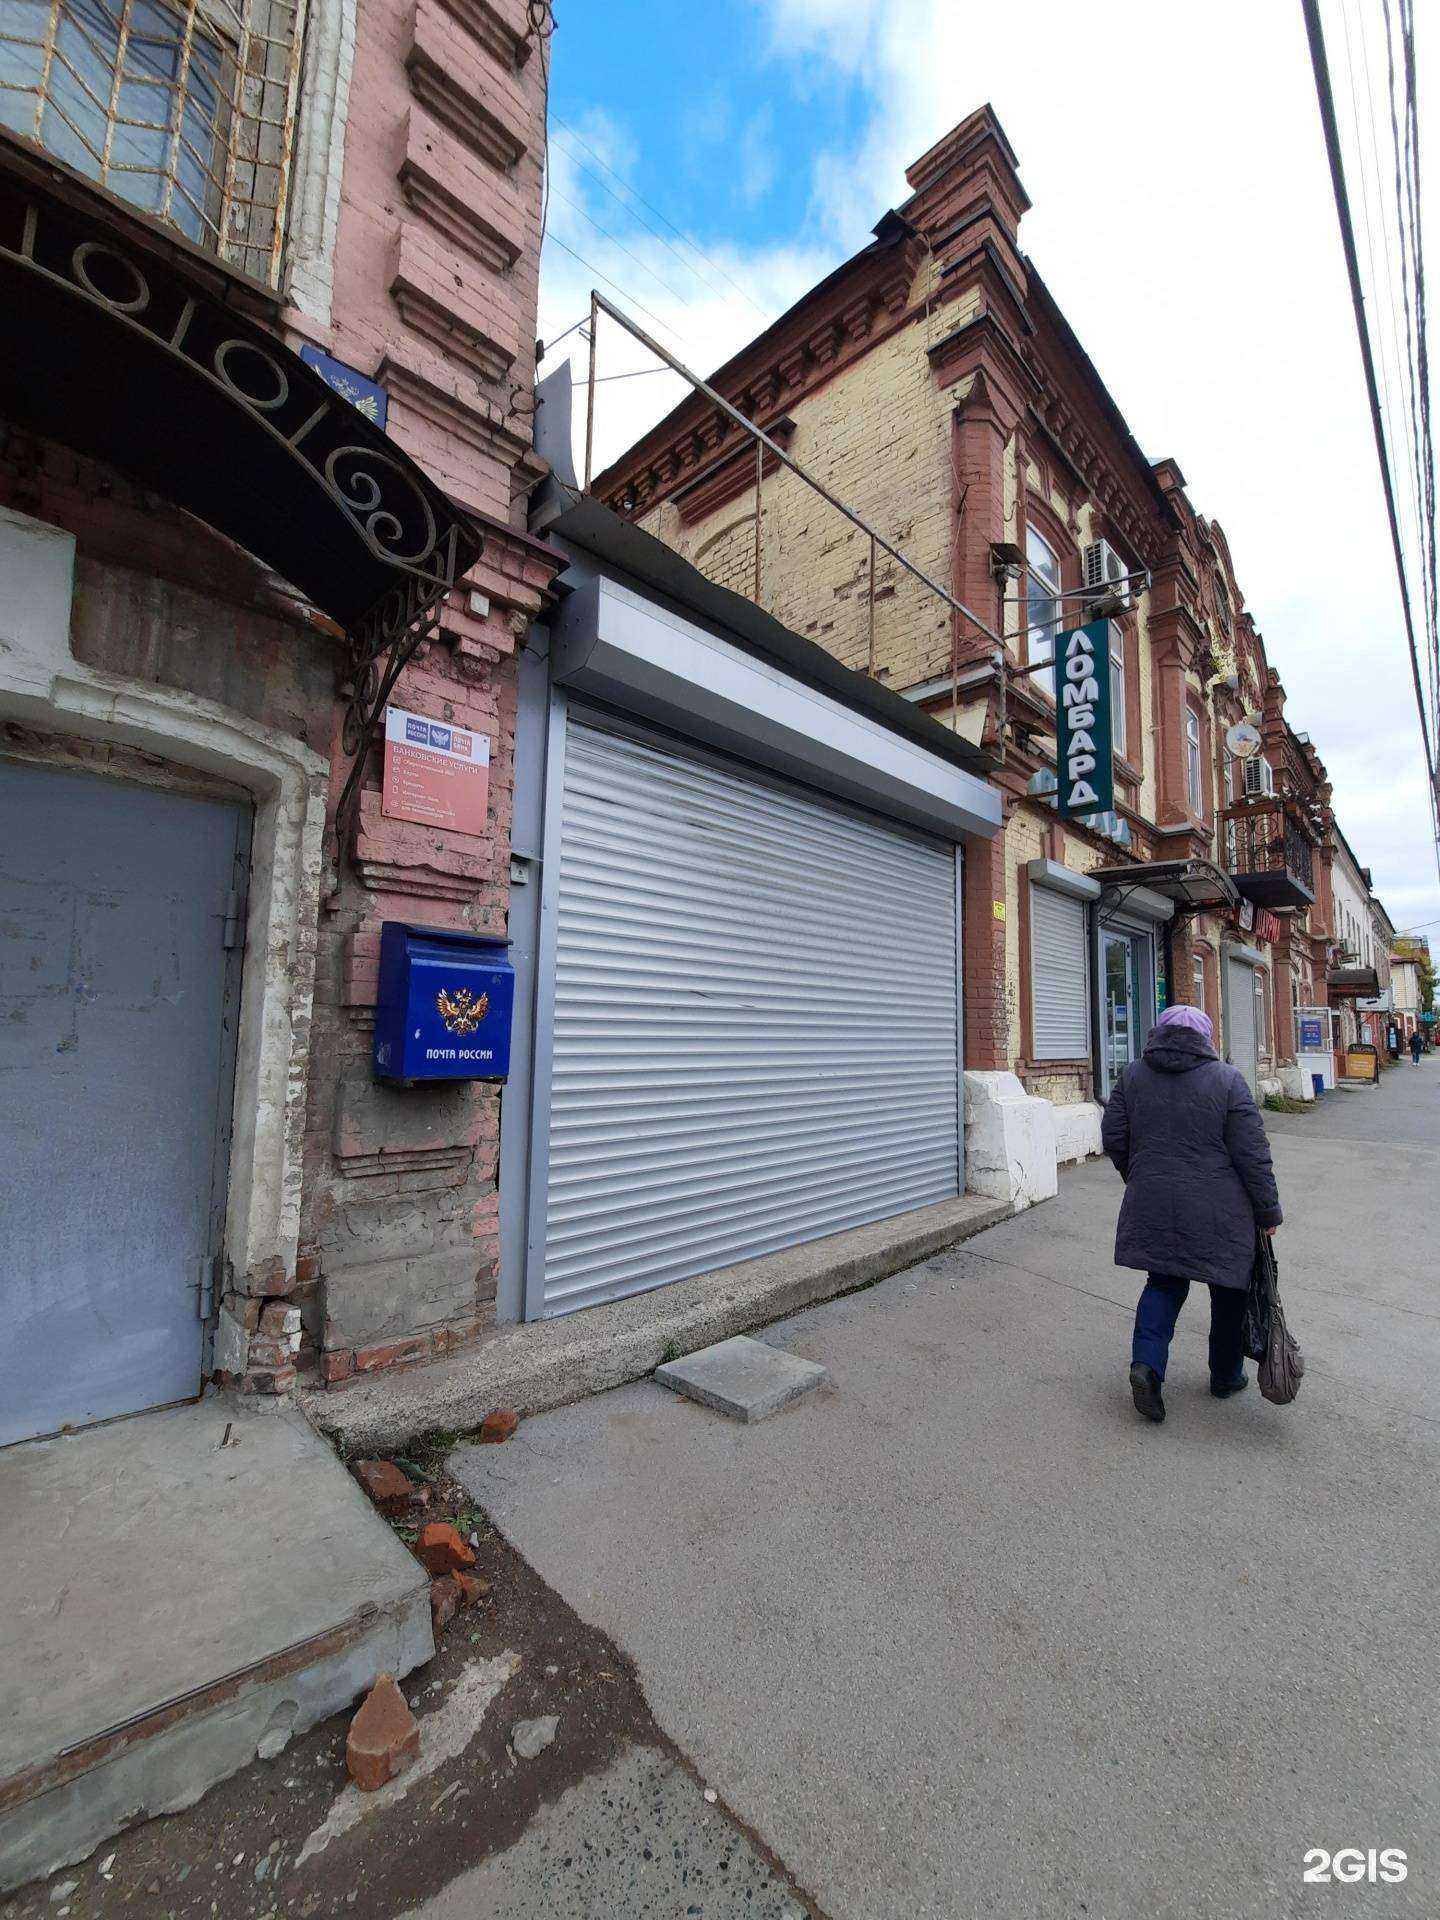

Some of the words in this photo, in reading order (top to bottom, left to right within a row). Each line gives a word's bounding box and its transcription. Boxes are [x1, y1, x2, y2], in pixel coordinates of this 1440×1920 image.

[407, 722, 427, 733] ПОЧТА
[1063, 629, 1100, 808] ЛОМБАРД
[393, 746, 447, 766] БАНКОВСКИЕ
[449, 762, 478, 774] УСЛУГИ
[426, 1049, 456, 1059] ПОЧТА
[459, 1049, 493, 1059] РОССИИ
